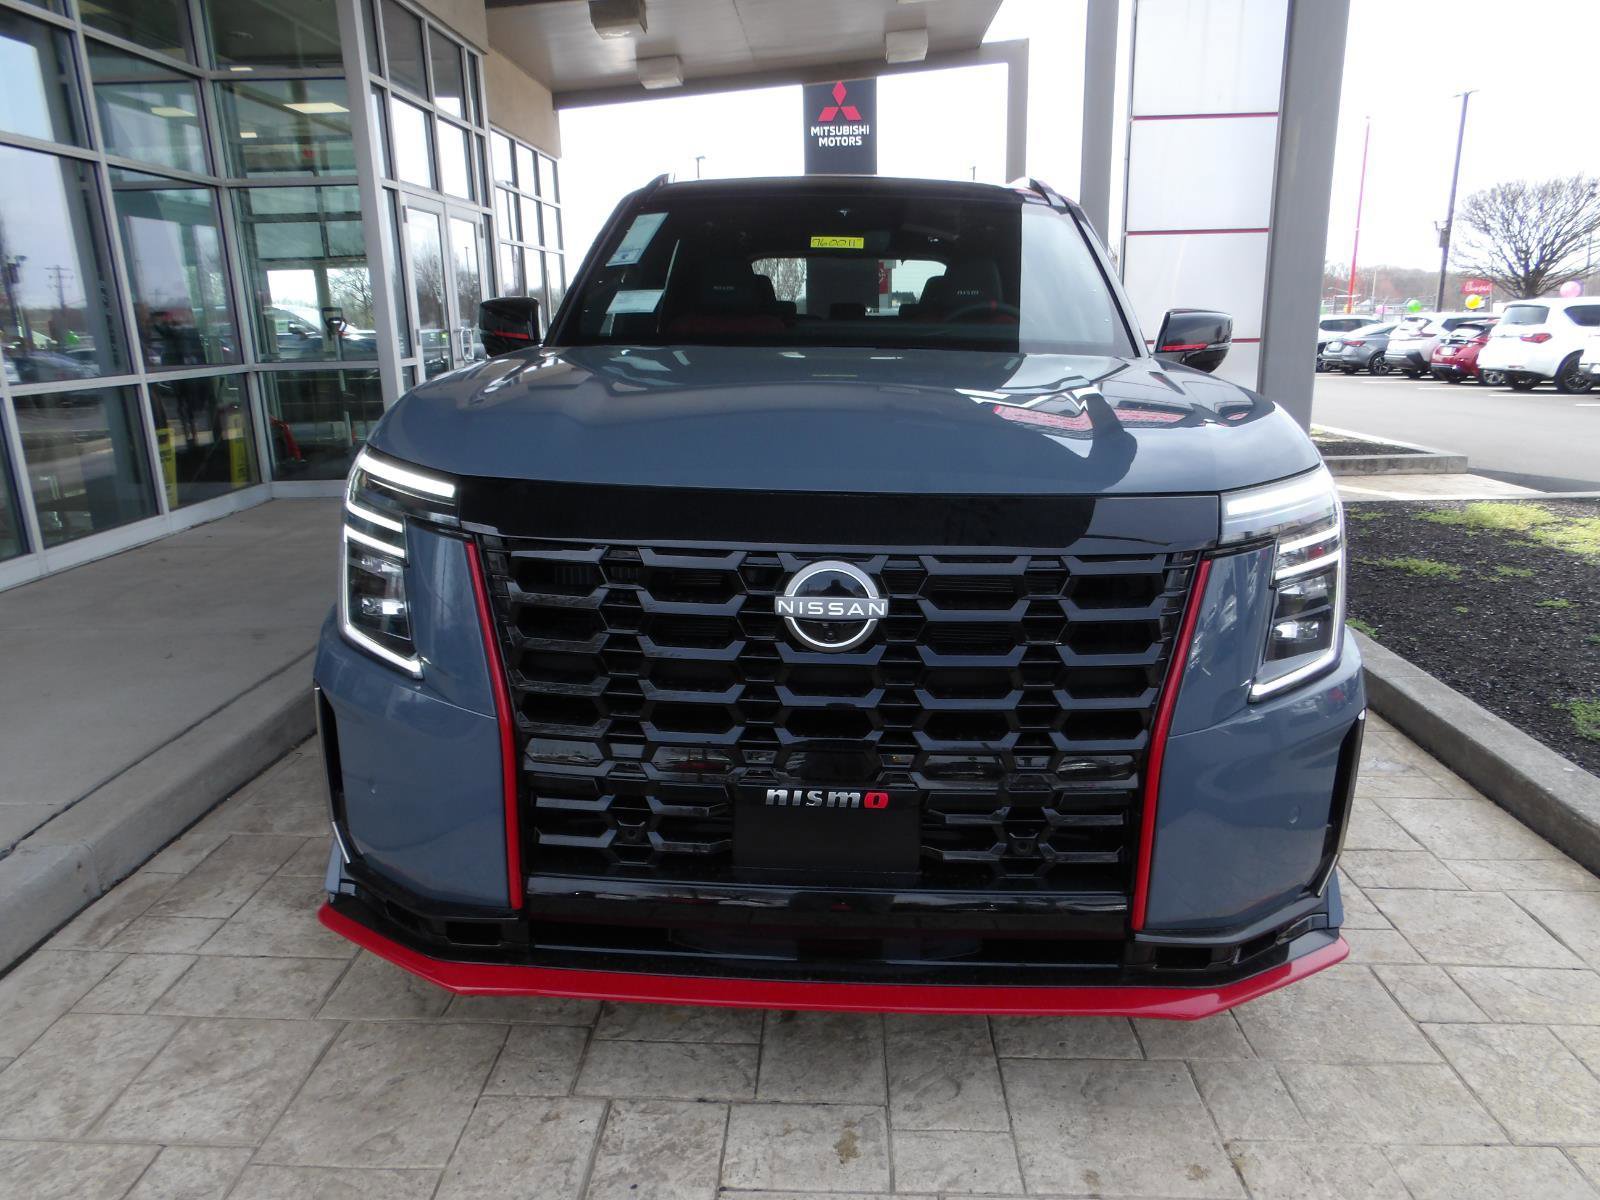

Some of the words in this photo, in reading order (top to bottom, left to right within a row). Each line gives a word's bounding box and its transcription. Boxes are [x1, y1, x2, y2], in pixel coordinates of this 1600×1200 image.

[810, 124, 870, 136] MITSUBISHI
[818, 136, 863, 147] MOTORS
[778, 600, 885, 616] NISSAN
[765, 789, 889, 809] nismo
